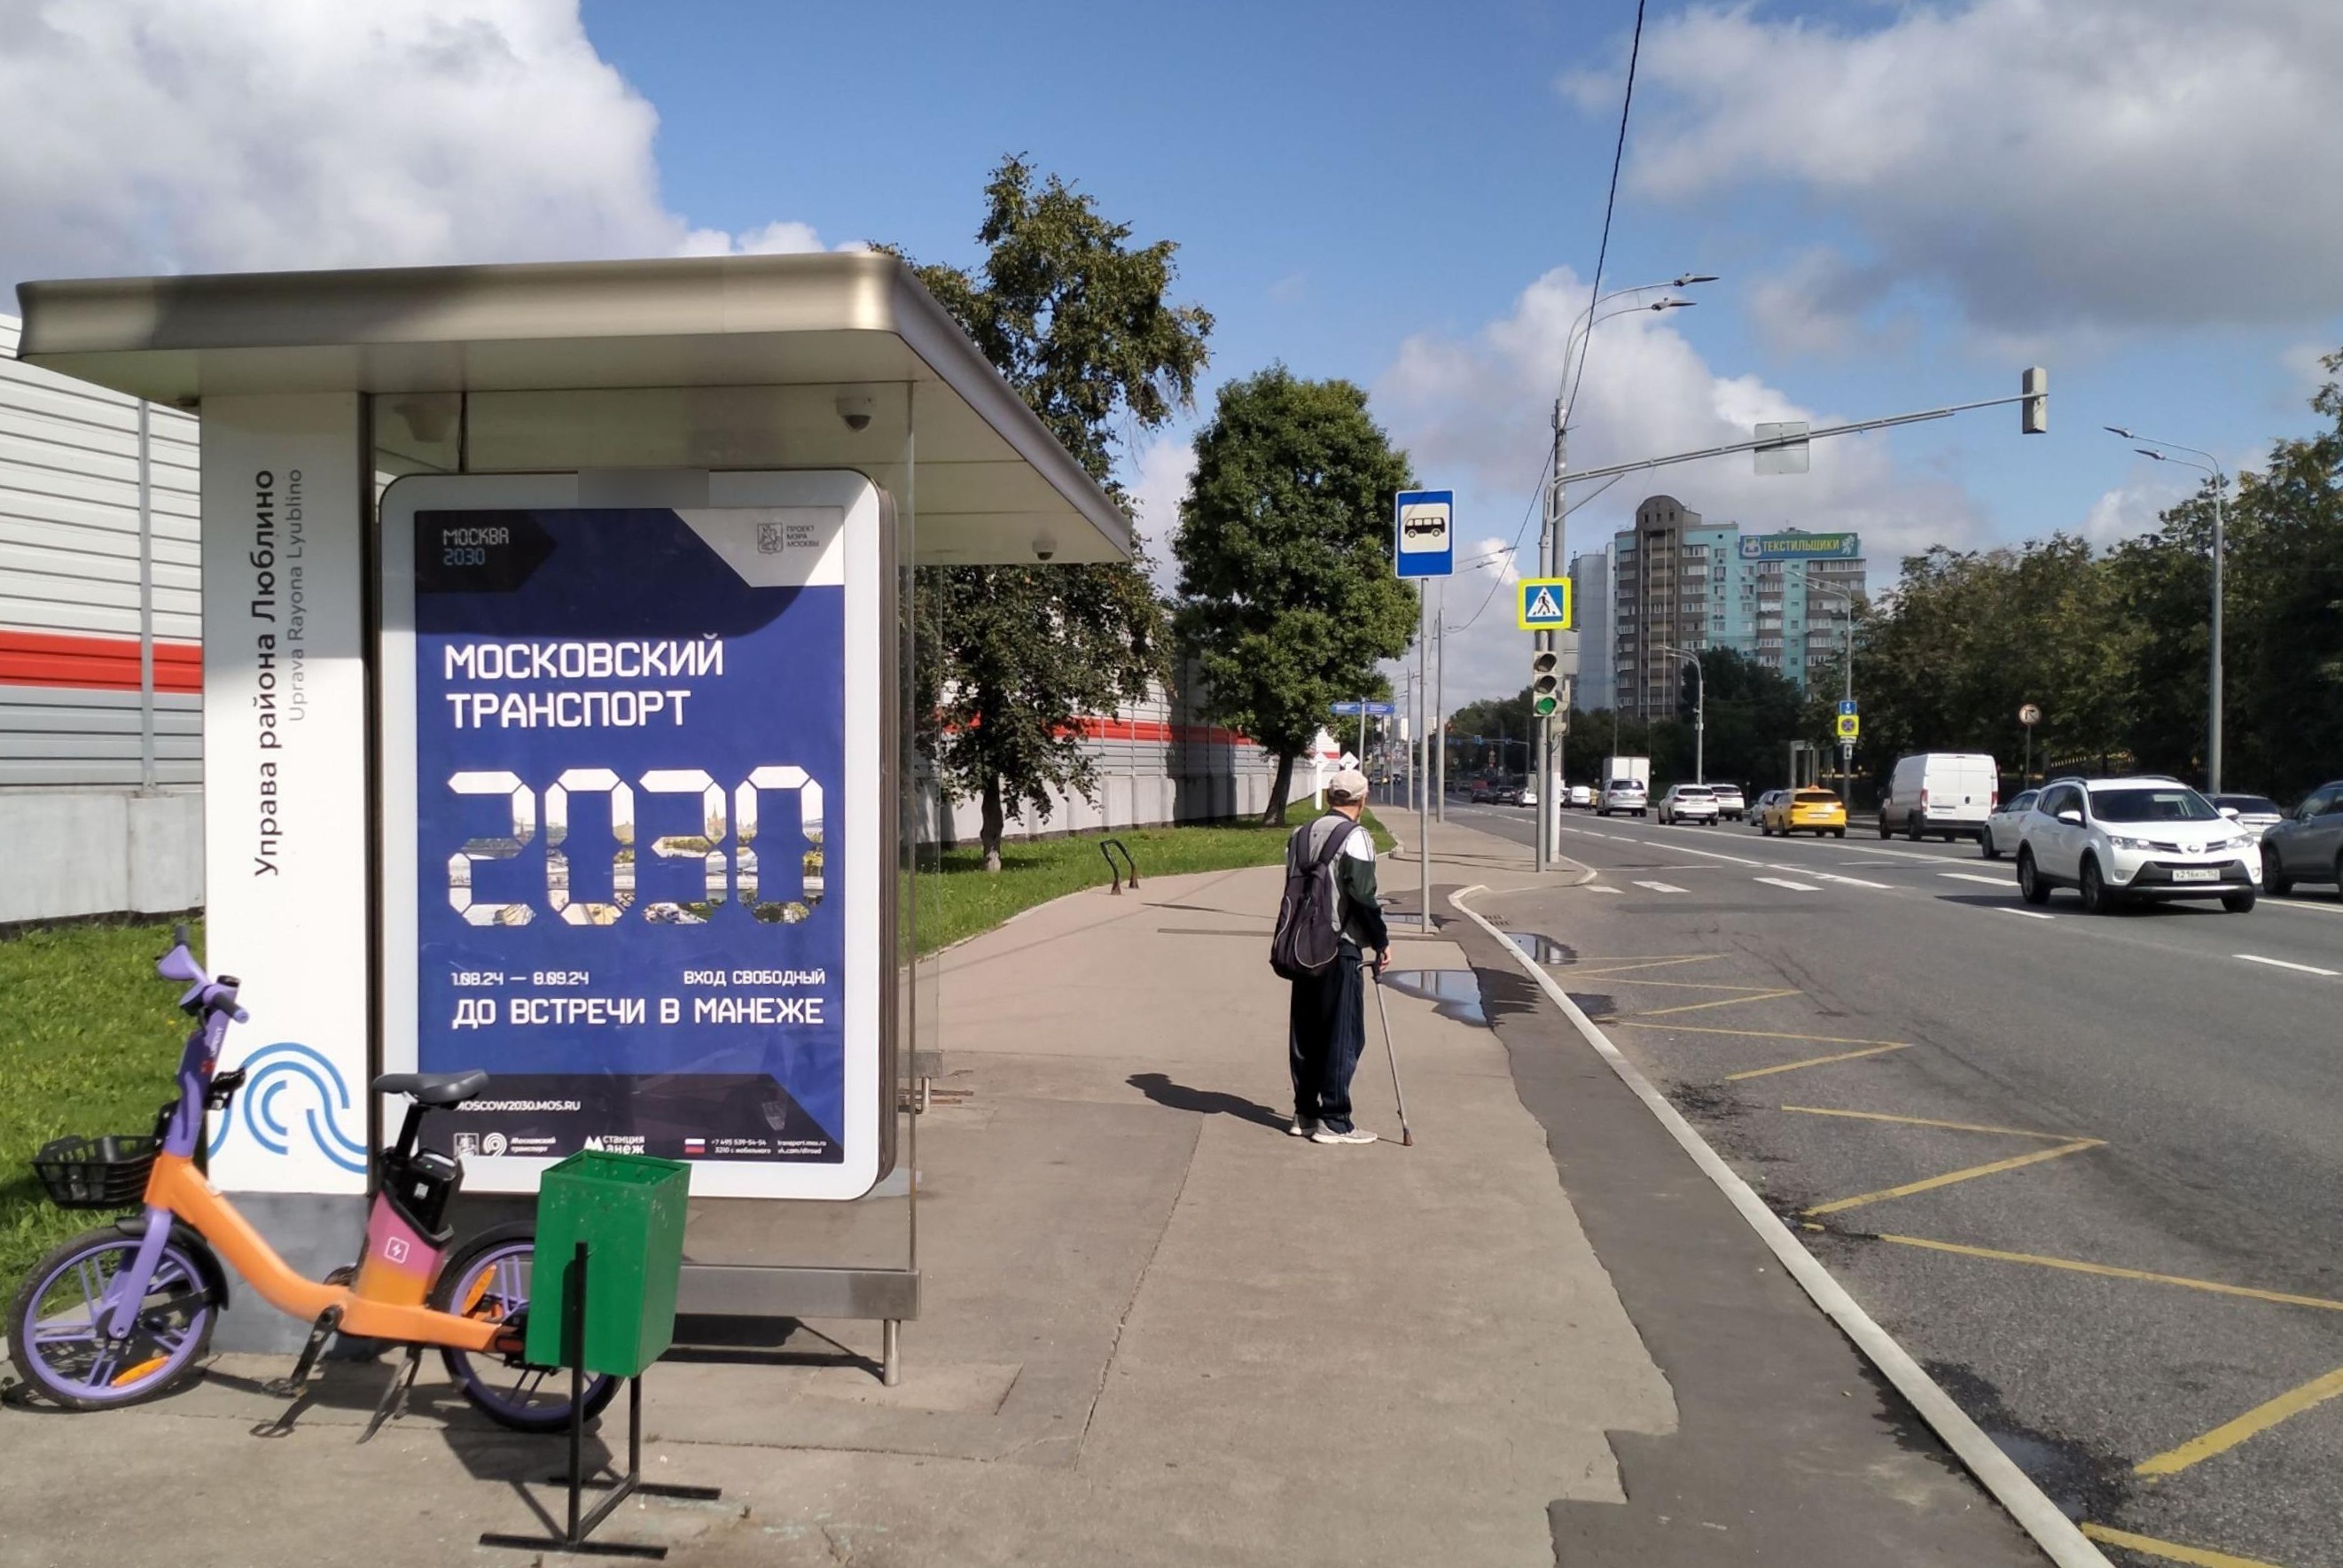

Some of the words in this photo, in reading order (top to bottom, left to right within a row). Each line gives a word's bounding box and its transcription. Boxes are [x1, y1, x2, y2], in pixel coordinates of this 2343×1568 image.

[285, 469, 306, 558] Lyublino
[250, 471, 276, 622] Люблино
[443, 527, 509, 546] МОСКВА
[444, 548, 485, 566] 2030
[1763, 539, 1839, 552] ТЕКСТИЛЬЩИКИ
[286, 566, 307, 641] Rayona
[445, 633, 723, 680] МОСКОВСКИЙ
[253, 634, 282, 748] района
[289, 649, 308, 721] Uprava
[446, 690, 691, 729] ТРАНСПОРТ
[254, 762, 283, 876] Управа
[447, 766, 824, 925] 2030
[450, 971, 504, 986] 1.08.24
[533, 971, 590, 986] 8.09.24
[683, 971, 727, 987] ВХОД
[732, 968, 825, 986] СВОБОДНЫЙ
[452, 998, 496, 1029] ДО
[511, 998, 645, 1025] ВСТРЕЧИ
[660, 998, 680, 1024] В
[694, 997, 824, 1025] МАНЕЖЕ
[603, 1135, 645, 1145] станция
